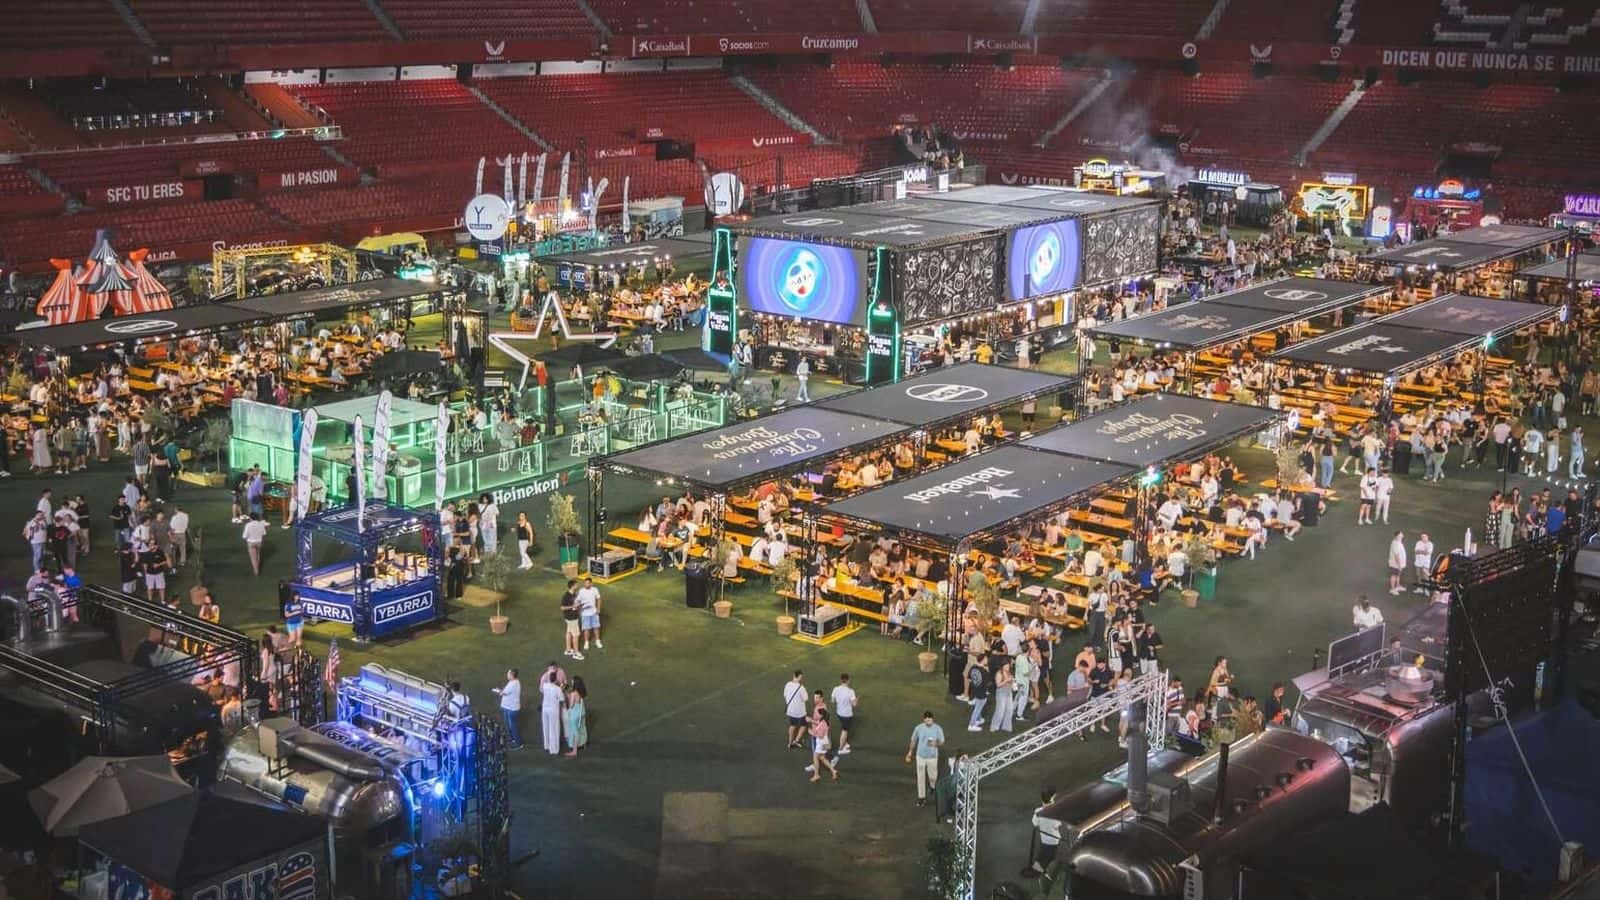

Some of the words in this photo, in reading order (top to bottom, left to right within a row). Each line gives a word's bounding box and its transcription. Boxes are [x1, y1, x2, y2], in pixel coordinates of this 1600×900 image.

[648, 40, 685, 52] CaixaBank
[730, 41, 769, 51] socios.com
[802, 35, 858, 51] Cruzcampo
[1383, 50, 1429, 66] DICEN
[1435, 51, 1467, 69] QUE
[1472, 52, 1528, 71] NUNCA
[1534, 55, 1555, 71] SE
[281, 172, 294, 187] MI
[298, 169, 337, 186] PASION
[1199, 168, 1208, 182] LA
[1208, 170, 1245, 185] MURALLA
[107, 187, 131, 204] SFC
[134, 186, 149, 201] TU
[153, 182, 184, 200] ERES
[702, 426, 778, 449] Burger
[713, 427, 821, 459] Champions
[769, 441, 817, 456] The
[491, 476, 559, 505] Heineken
[903, 466, 1015, 504] Heineken
[379, 597, 428, 619] YBARRA
